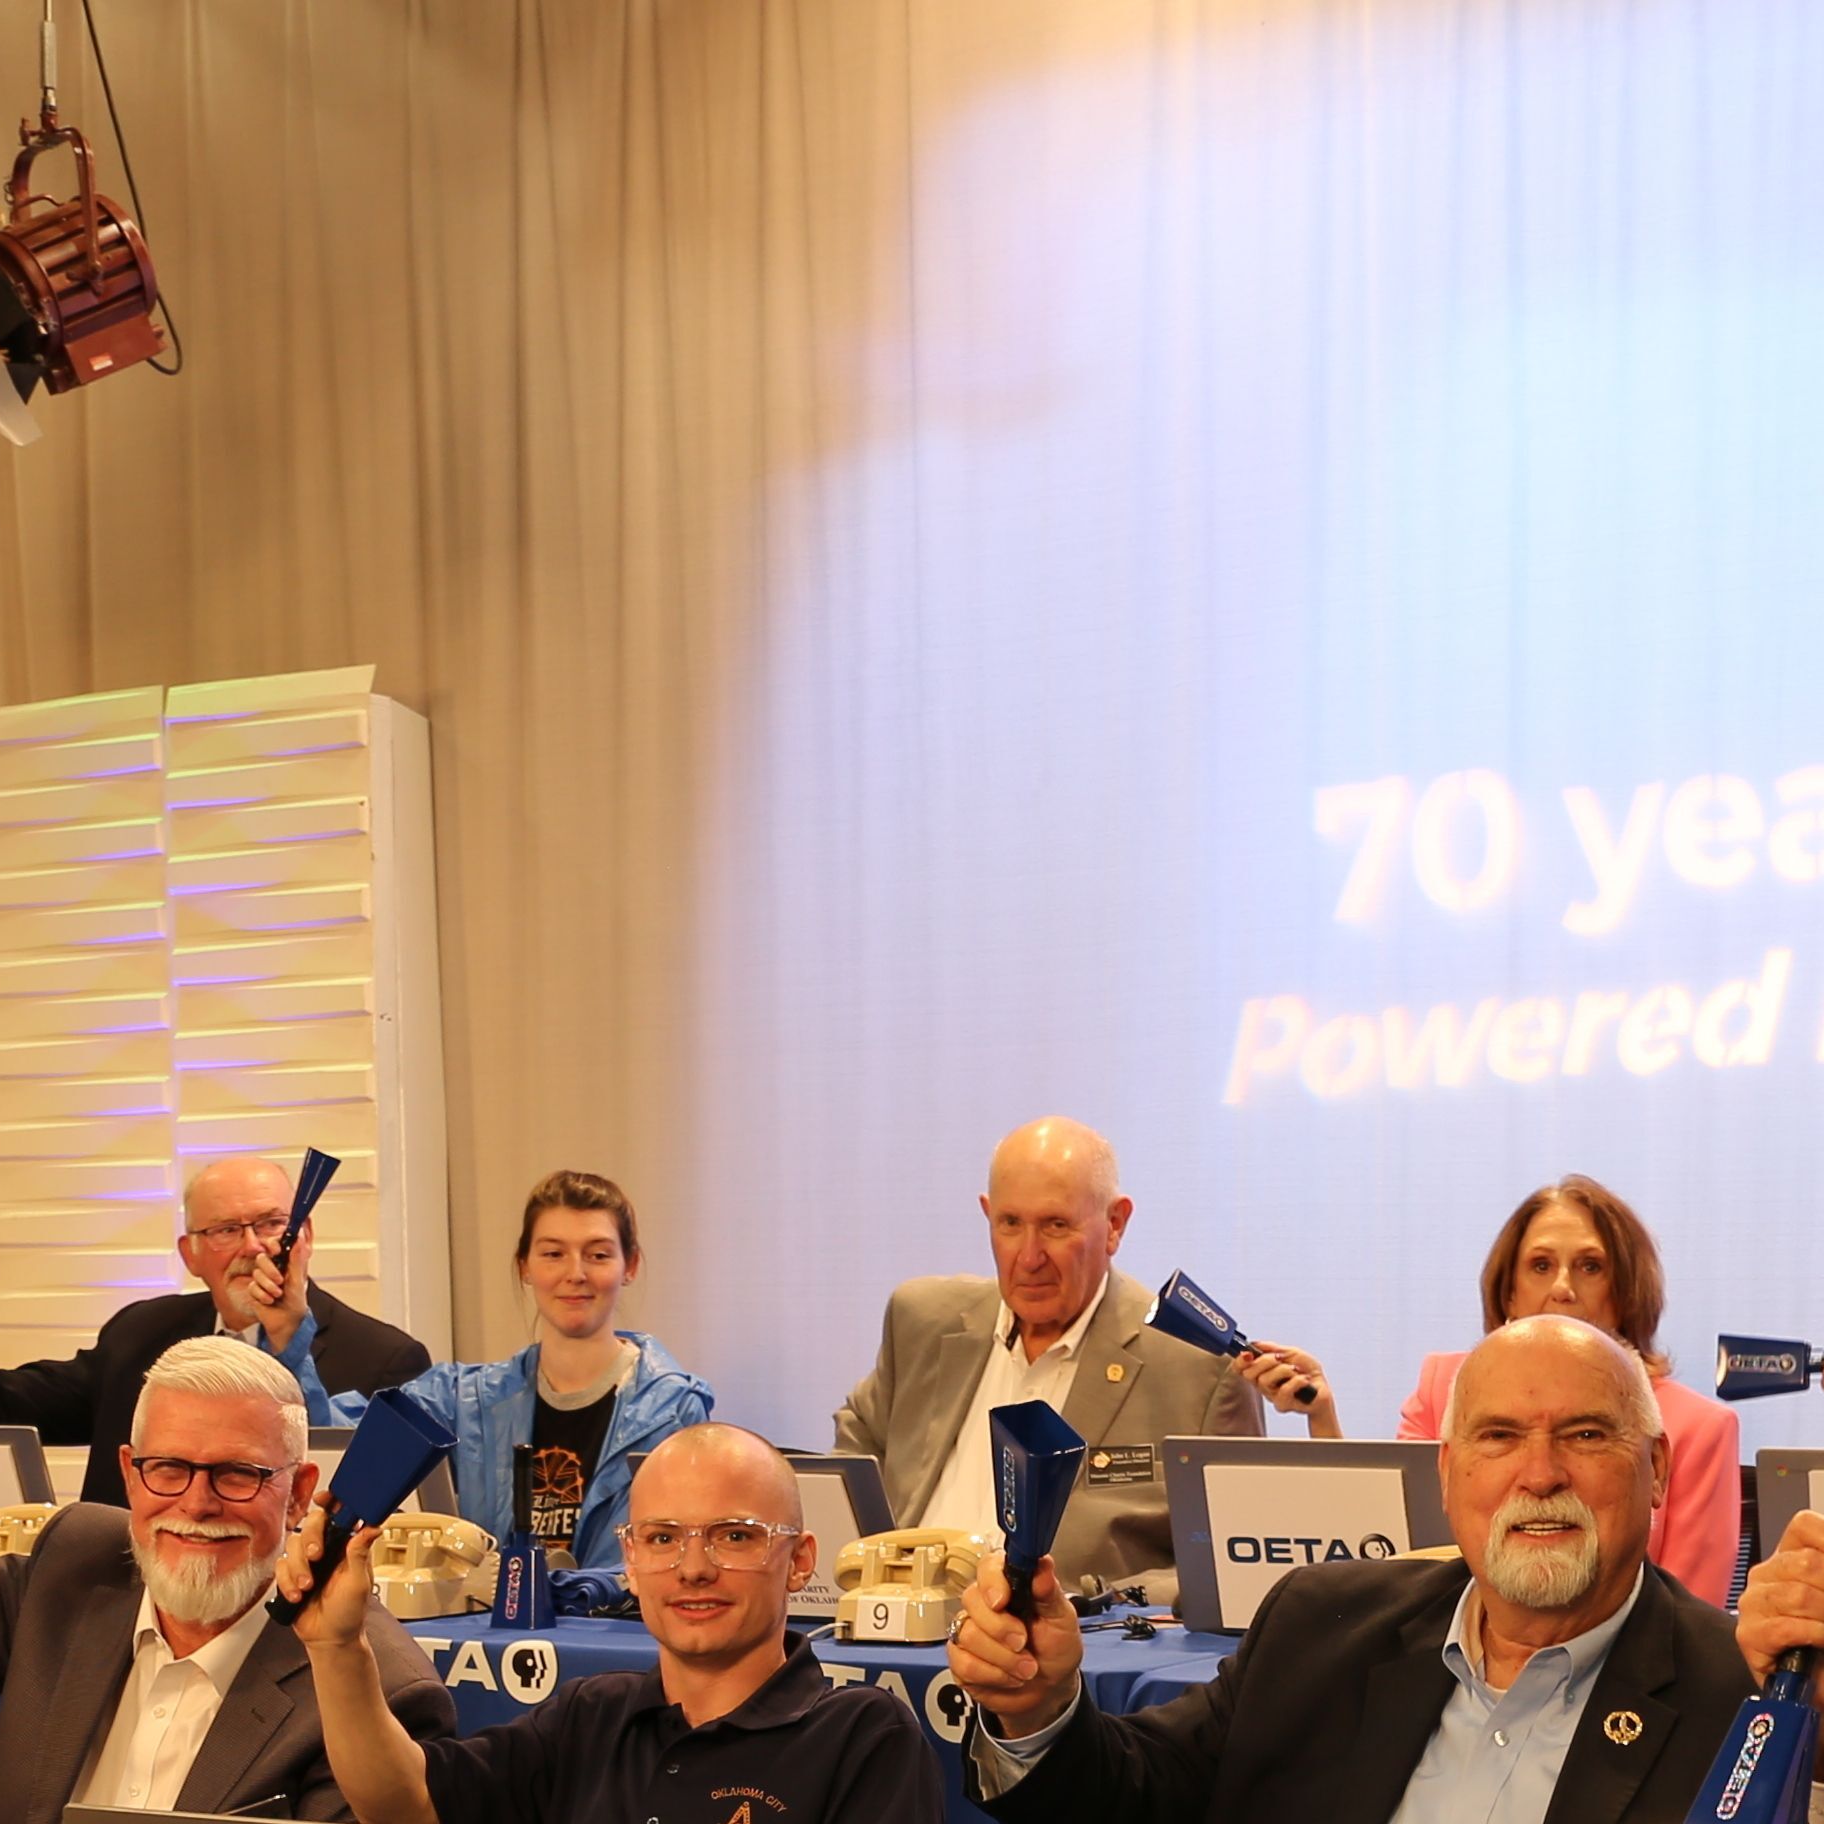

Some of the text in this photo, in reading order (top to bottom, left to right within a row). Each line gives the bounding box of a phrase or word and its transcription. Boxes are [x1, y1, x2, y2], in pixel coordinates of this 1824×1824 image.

[1314, 767, 1522, 926] 70
[1222, 948, 1791, 1107] Powered
[1227, 1536, 1355, 1564] OETA
[873, 1602, 889, 1631] 9
[711, 1787, 788, 1813] OKLAHOMA CITY
